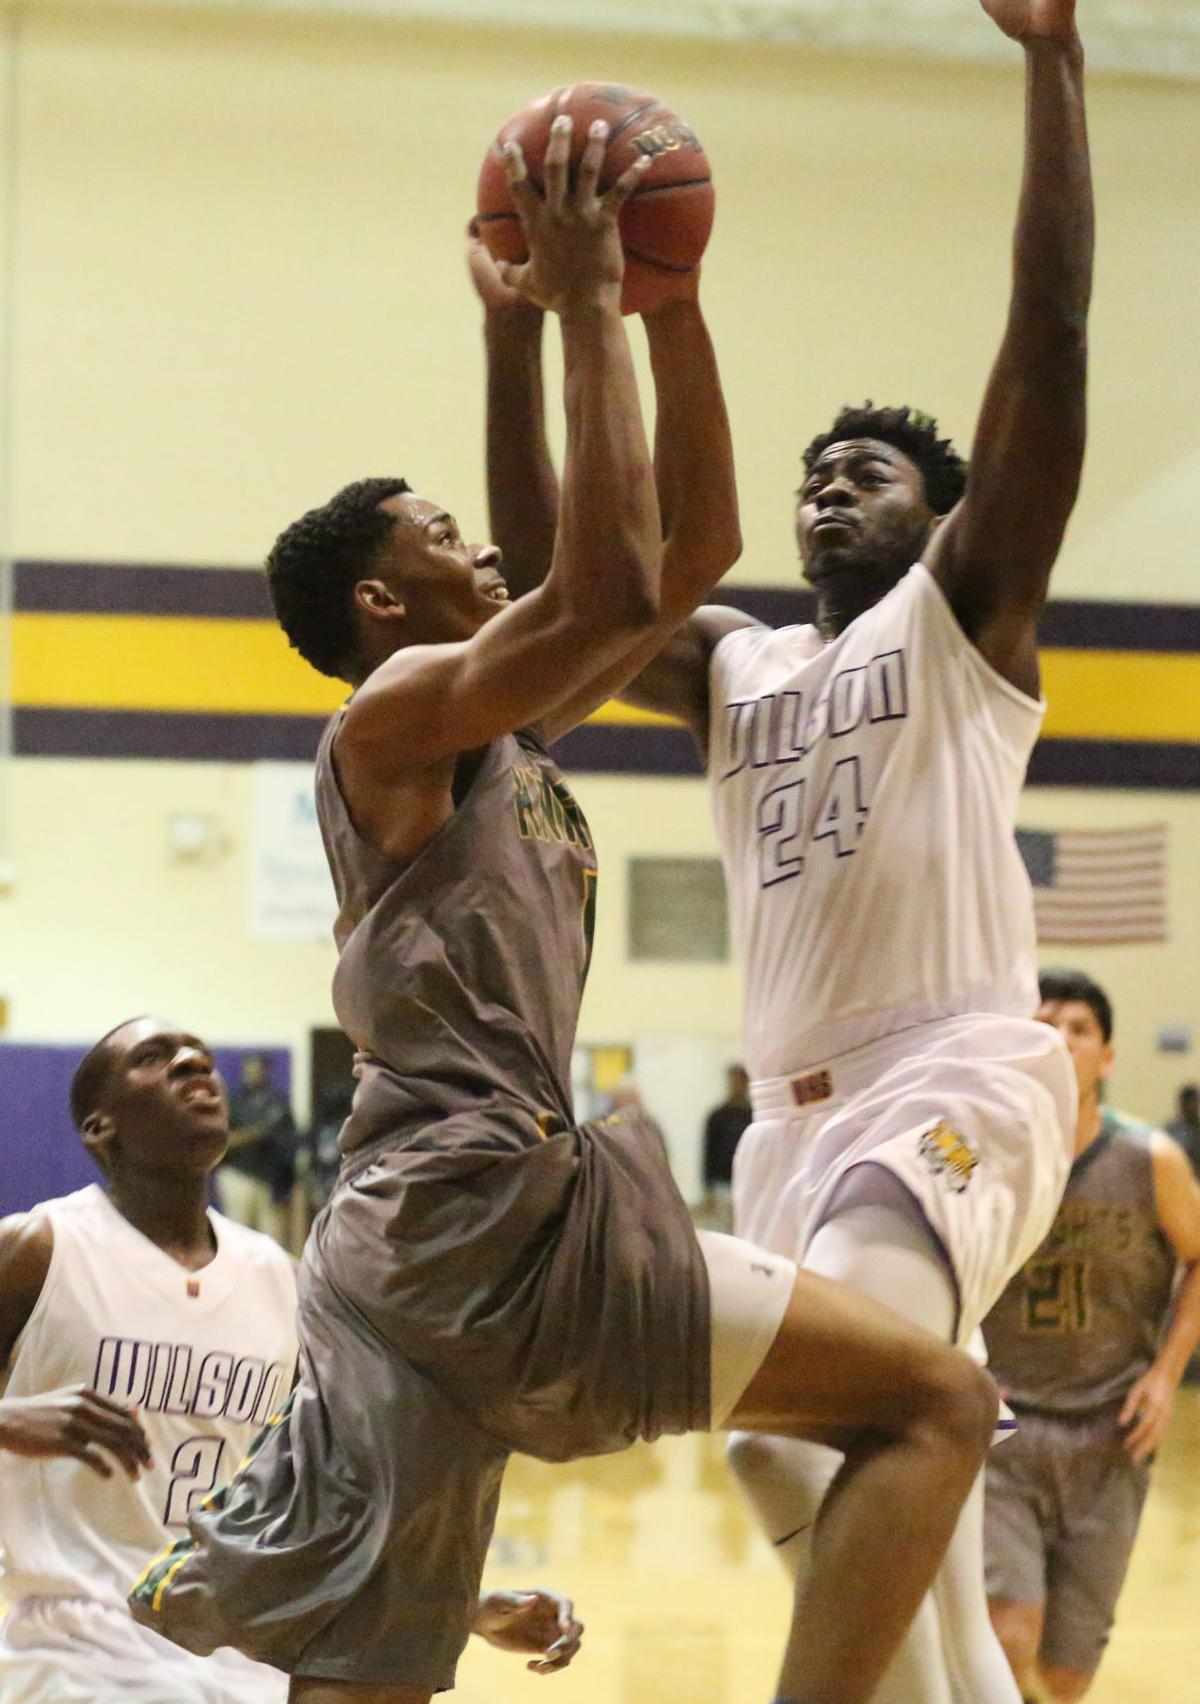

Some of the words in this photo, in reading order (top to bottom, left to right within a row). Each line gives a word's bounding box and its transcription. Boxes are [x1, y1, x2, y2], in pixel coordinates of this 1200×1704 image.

[758, 755, 868, 889] 24
[1023, 1257, 1092, 1333] 21
[163, 1436, 226, 1527] 2
